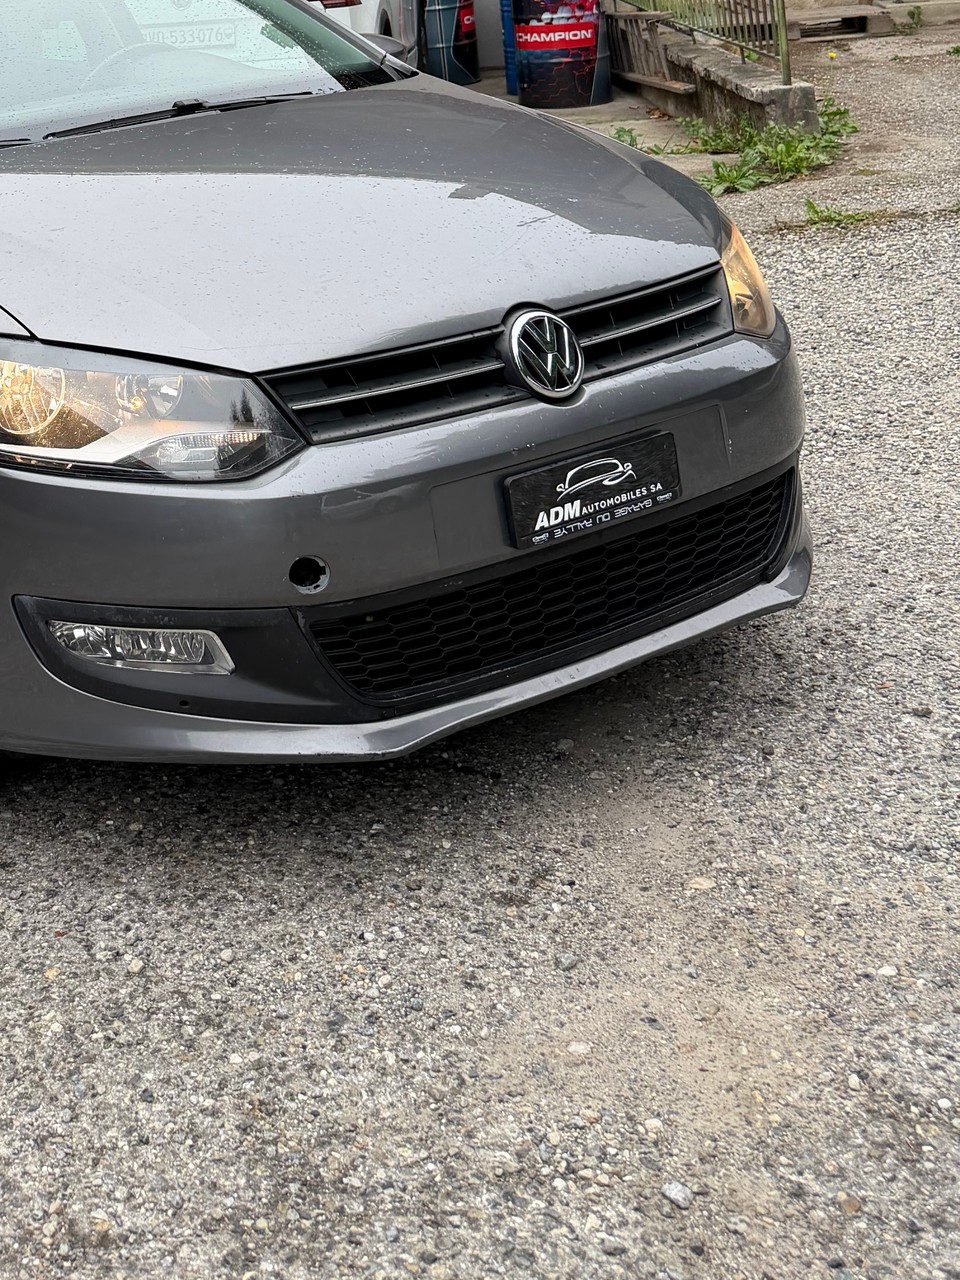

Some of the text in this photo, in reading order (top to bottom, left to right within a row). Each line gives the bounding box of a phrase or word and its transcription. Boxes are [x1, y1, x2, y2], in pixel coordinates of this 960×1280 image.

[516, 29, 592, 42] CHAMPION
[534, 482, 663, 531] ADM AUTOMOBILES SA
[553, 498, 653, 538] GARAGE DU RALLYE
